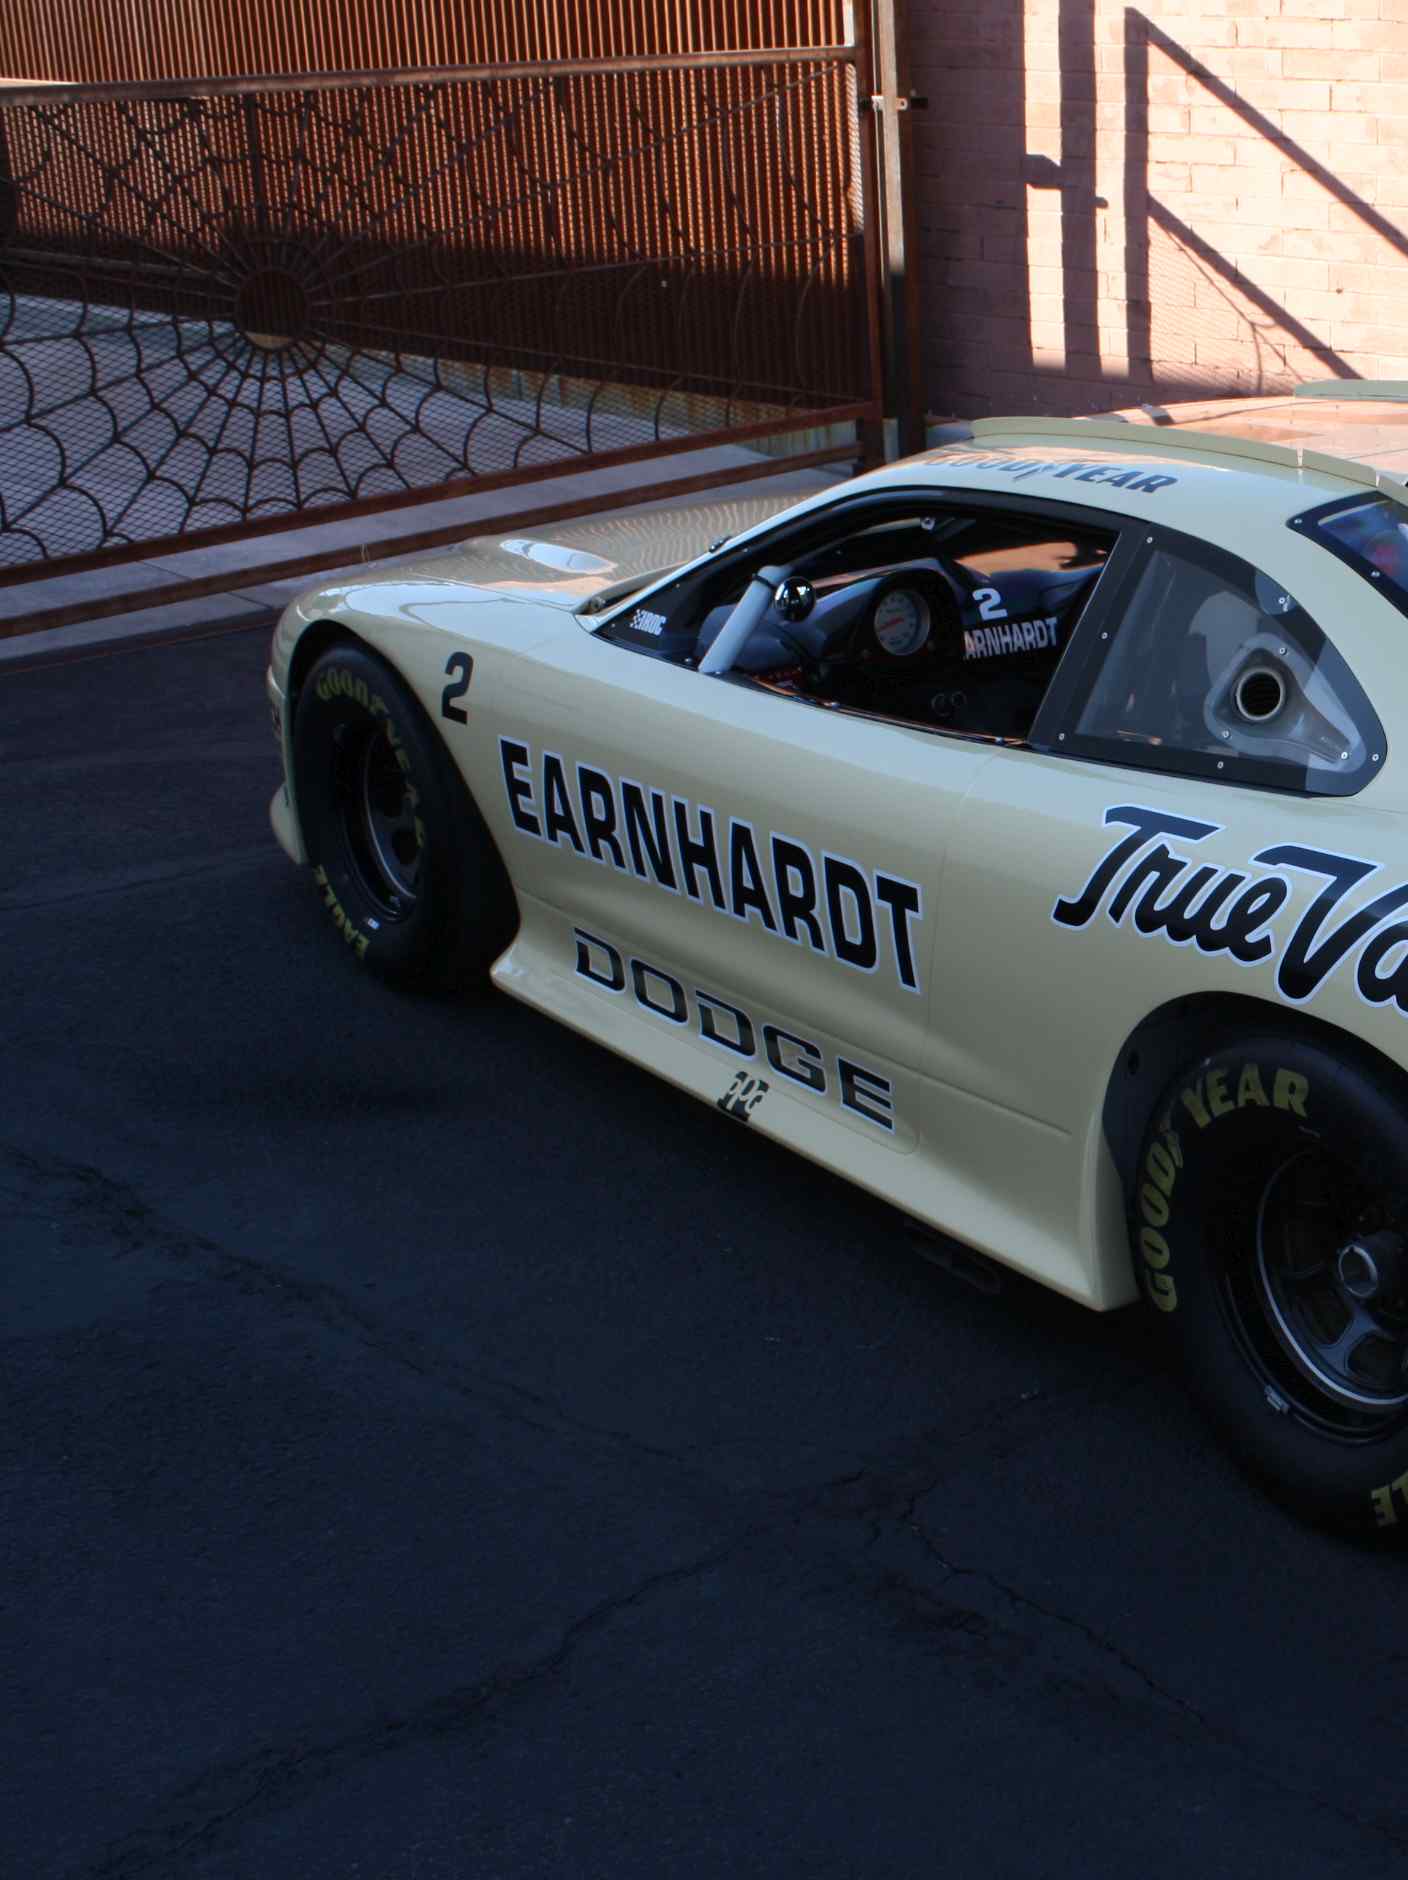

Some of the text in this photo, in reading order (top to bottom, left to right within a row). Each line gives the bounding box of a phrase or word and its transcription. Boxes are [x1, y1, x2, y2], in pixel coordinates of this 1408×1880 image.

[961, 616, 1059, 660] ARNHARDT
[972, 587, 1008, 621] 2
[441, 651, 474, 725] 2
[499, 735, 922, 994] EARNHARDT
[1052, 804, 1292, 963] True
[572, 926, 896, 1134] DODGE
